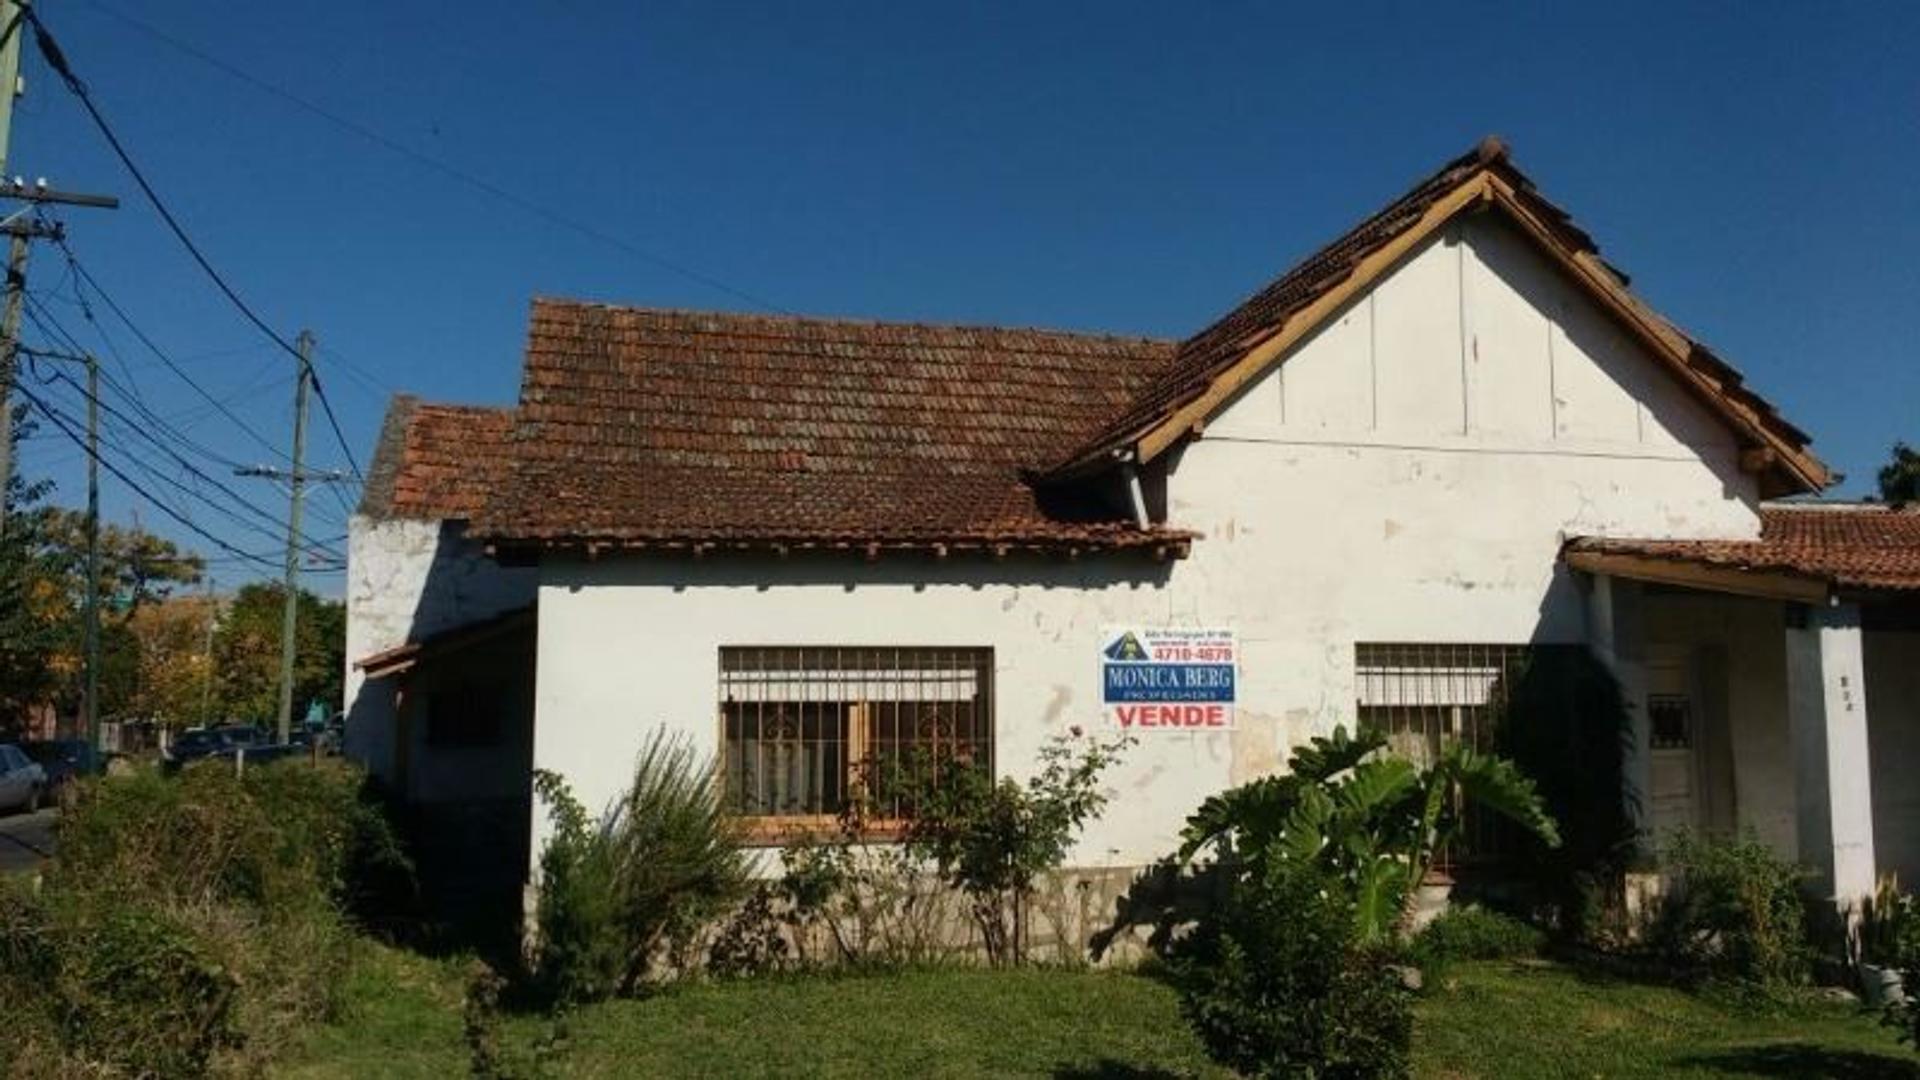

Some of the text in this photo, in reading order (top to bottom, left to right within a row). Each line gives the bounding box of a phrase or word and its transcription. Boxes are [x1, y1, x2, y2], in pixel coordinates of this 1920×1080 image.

[1108, 667, 1230, 688] MONICA BERG
[1115, 705, 1224, 727] VENDE
